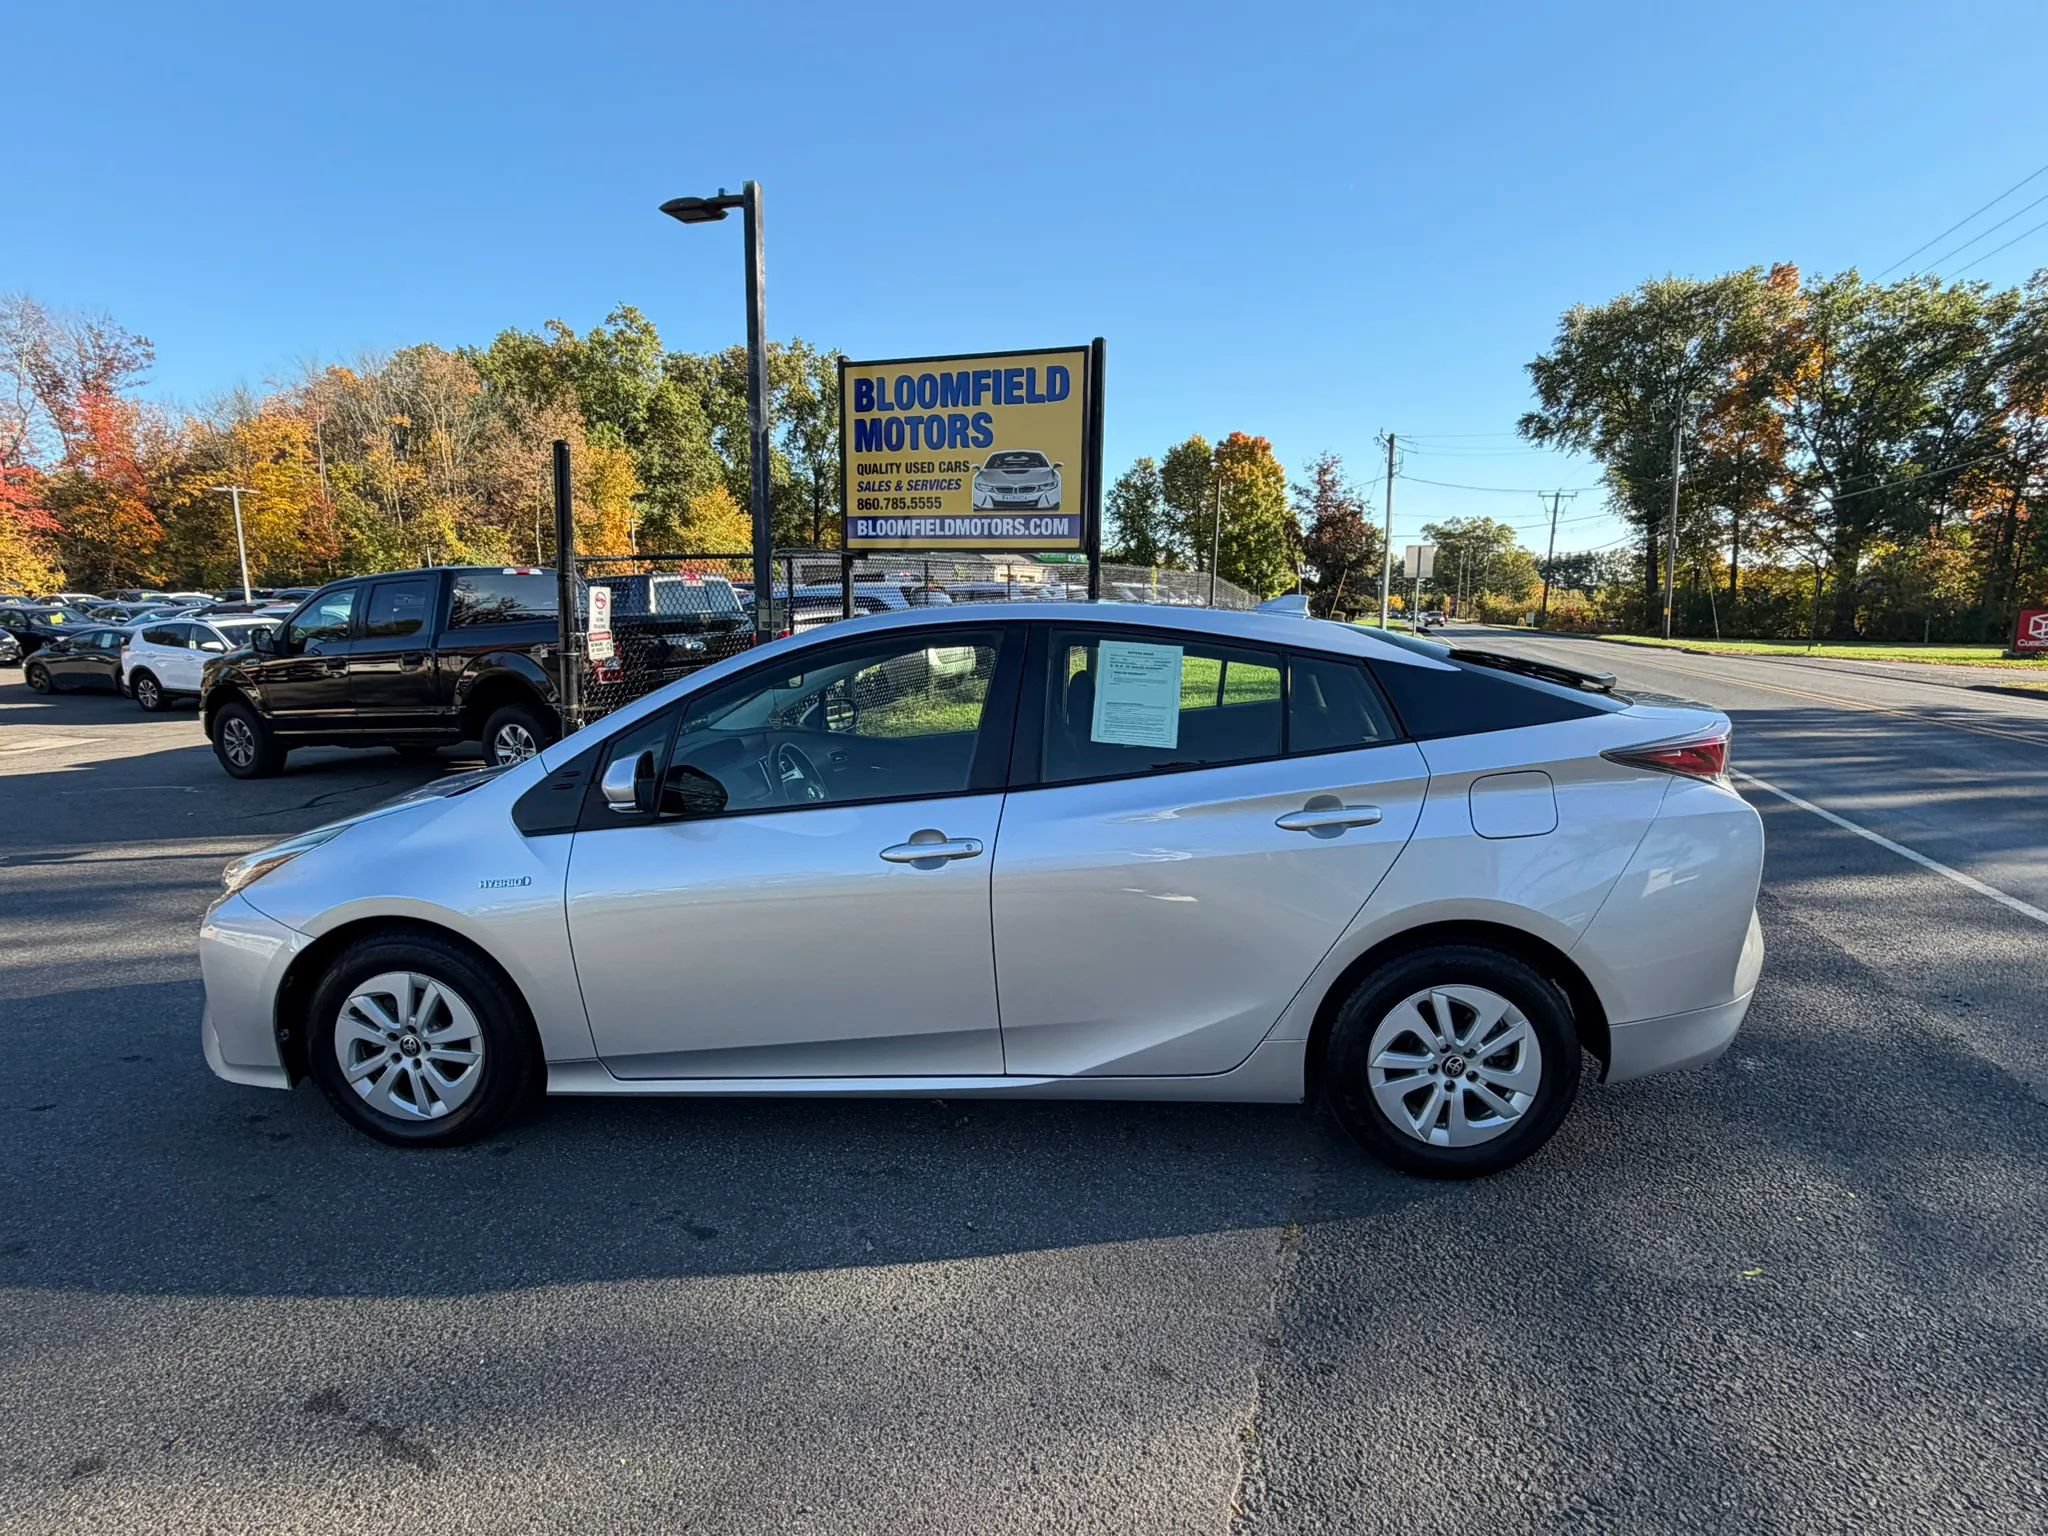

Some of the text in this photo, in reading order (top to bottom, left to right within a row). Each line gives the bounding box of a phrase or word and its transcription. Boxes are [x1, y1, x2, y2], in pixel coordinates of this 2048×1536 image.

[853, 365, 1071, 413] BLOOMFIELD
[854, 412, 994, 453] MOTORS
[856, 460, 970, 475] QUALITY USED CARS
[856, 478, 962, 493] SALES & SERVICES
[856, 496, 942, 511] 860.785.5555
[857, 518, 1069, 537] BLOOMFIELDMOTORS.COM
[479, 878, 523, 889] HYBRID
